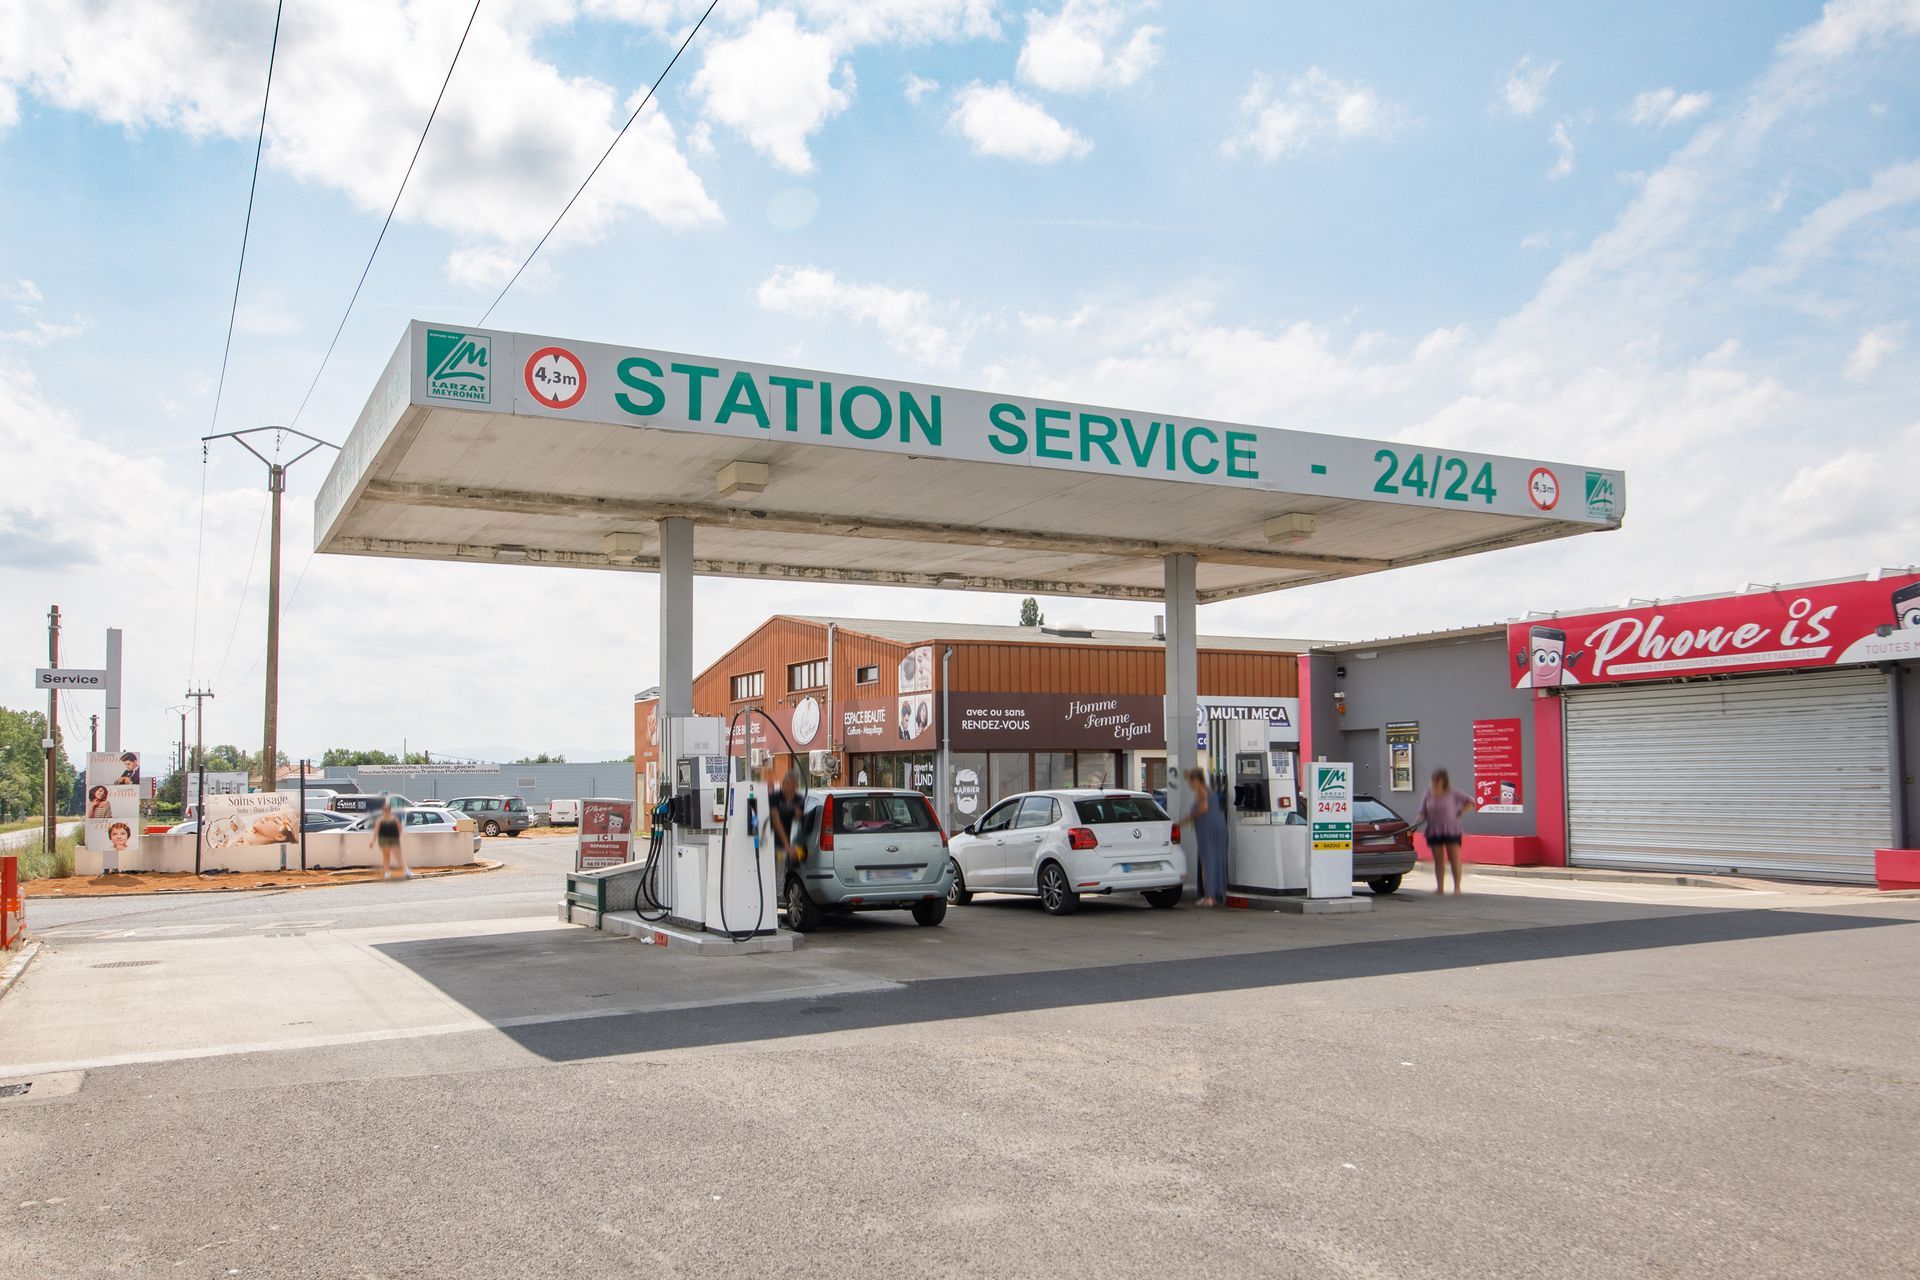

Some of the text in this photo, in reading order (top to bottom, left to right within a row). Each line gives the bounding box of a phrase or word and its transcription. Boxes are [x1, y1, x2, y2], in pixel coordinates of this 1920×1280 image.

[535, 366, 577, 386] 4,3m
[432, 381, 486, 392] LARZAT
[432, 388, 486, 400] MEYRONNE
[614, 356, 942, 447] STATION
[988, 402, 1260, 480] SERVICE
[1373, 448, 1497, 504] 24/24
[1533, 481, 1554, 494] 4,3m
[1584, 598, 1838, 677] Phone is
[1865, 642, 1910, 654] TOUTES
[42, 674, 98, 684] Service
[844, 706, 886, 725] ESPACE BEAUTÉ
[1065, 699, 1117, 720] Homme
[1210, 707, 1286, 720] MULTI MECA
[962, 720, 1030, 730] RENDEZ-VOUS
[1084, 713, 1130, 729] Femme
[1114, 722, 1152, 740] Enfant
[915, 774, 932, 786] LUND
[954, 785, 980, 794] BARBIER
[228, 795, 288, 806] Soins visage
[584, 805, 613, 815] Phone
[1318, 802, 1347, 813] 24/24
